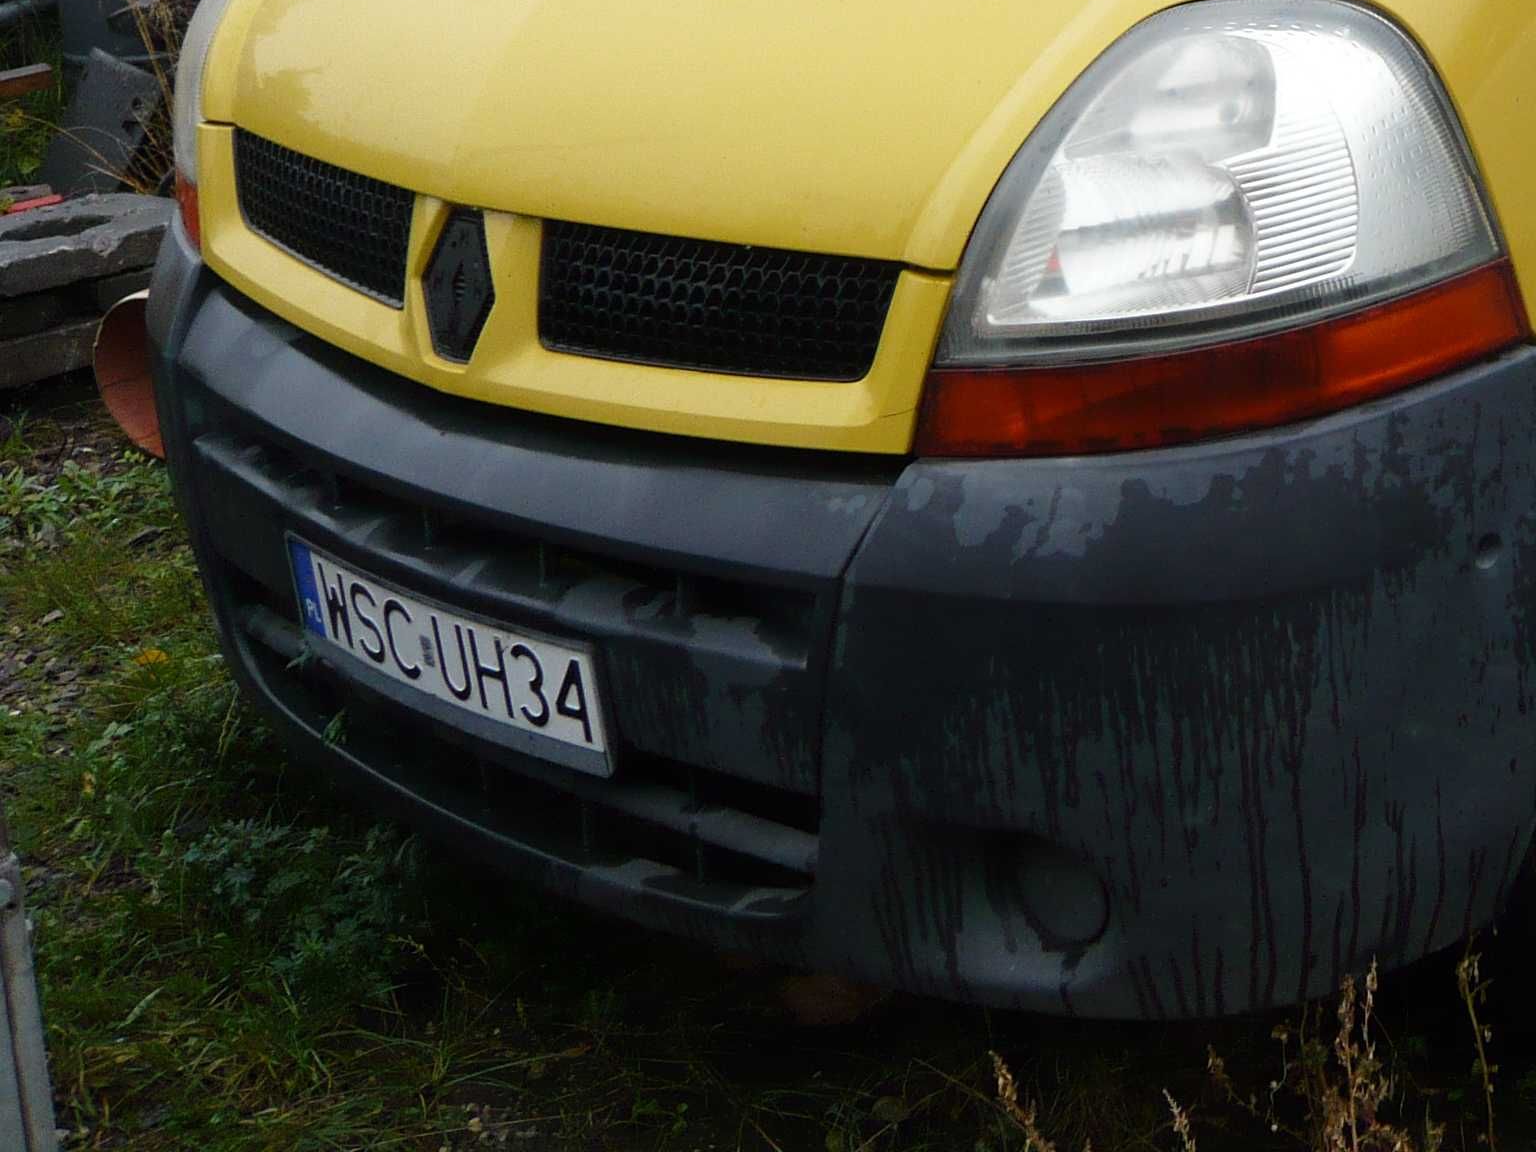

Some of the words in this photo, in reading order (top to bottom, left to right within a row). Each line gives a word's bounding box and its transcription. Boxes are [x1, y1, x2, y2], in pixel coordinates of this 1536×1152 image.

[304, 597, 322, 624] PL
[317, 563, 421, 680] WSC
[430, 615, 594, 743] UH34
